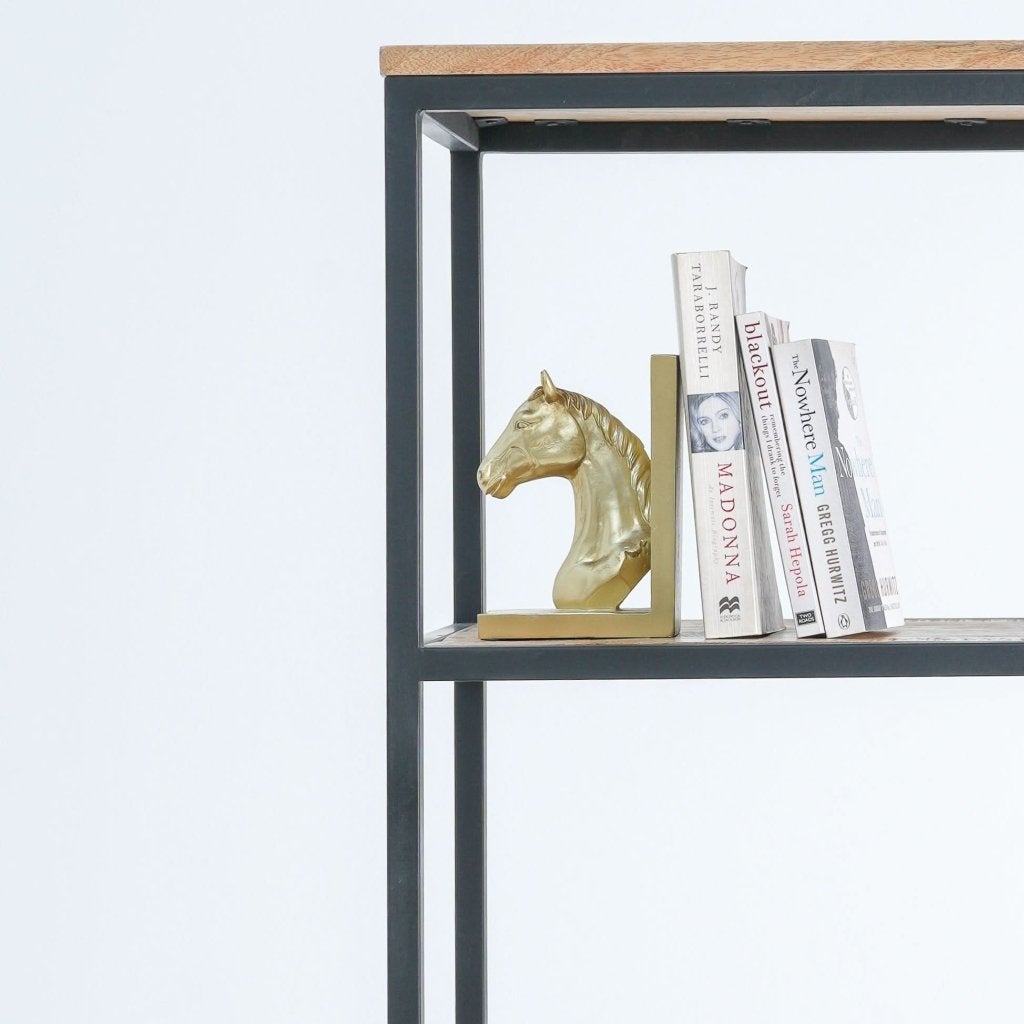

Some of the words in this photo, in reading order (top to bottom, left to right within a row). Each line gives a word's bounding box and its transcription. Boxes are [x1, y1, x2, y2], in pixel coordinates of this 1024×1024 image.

[705, 286, 717, 296] J.
[692, 263, 709, 379] TARABORRELLI
[709, 303, 722, 354] RANDY
[744, 320, 773, 410] blackout
[792, 354, 800, 369] The
[761, 415, 770, 438] things
[792, 368, 817, 450] Nowhere
[767, 444, 776, 466] drank
[770, 414, 783, 462] remembering
[771, 467, 777, 475] to
[773, 476, 782, 498] forget
[808, 451, 827, 497] Man
[718, 462, 740, 585] MADONNA
[781, 503, 798, 543] Sarah
[817, 504, 836, 545] GREGG
[789, 546, 808, 597] Hepola
[825, 548, 847, 604] HURWITZ
